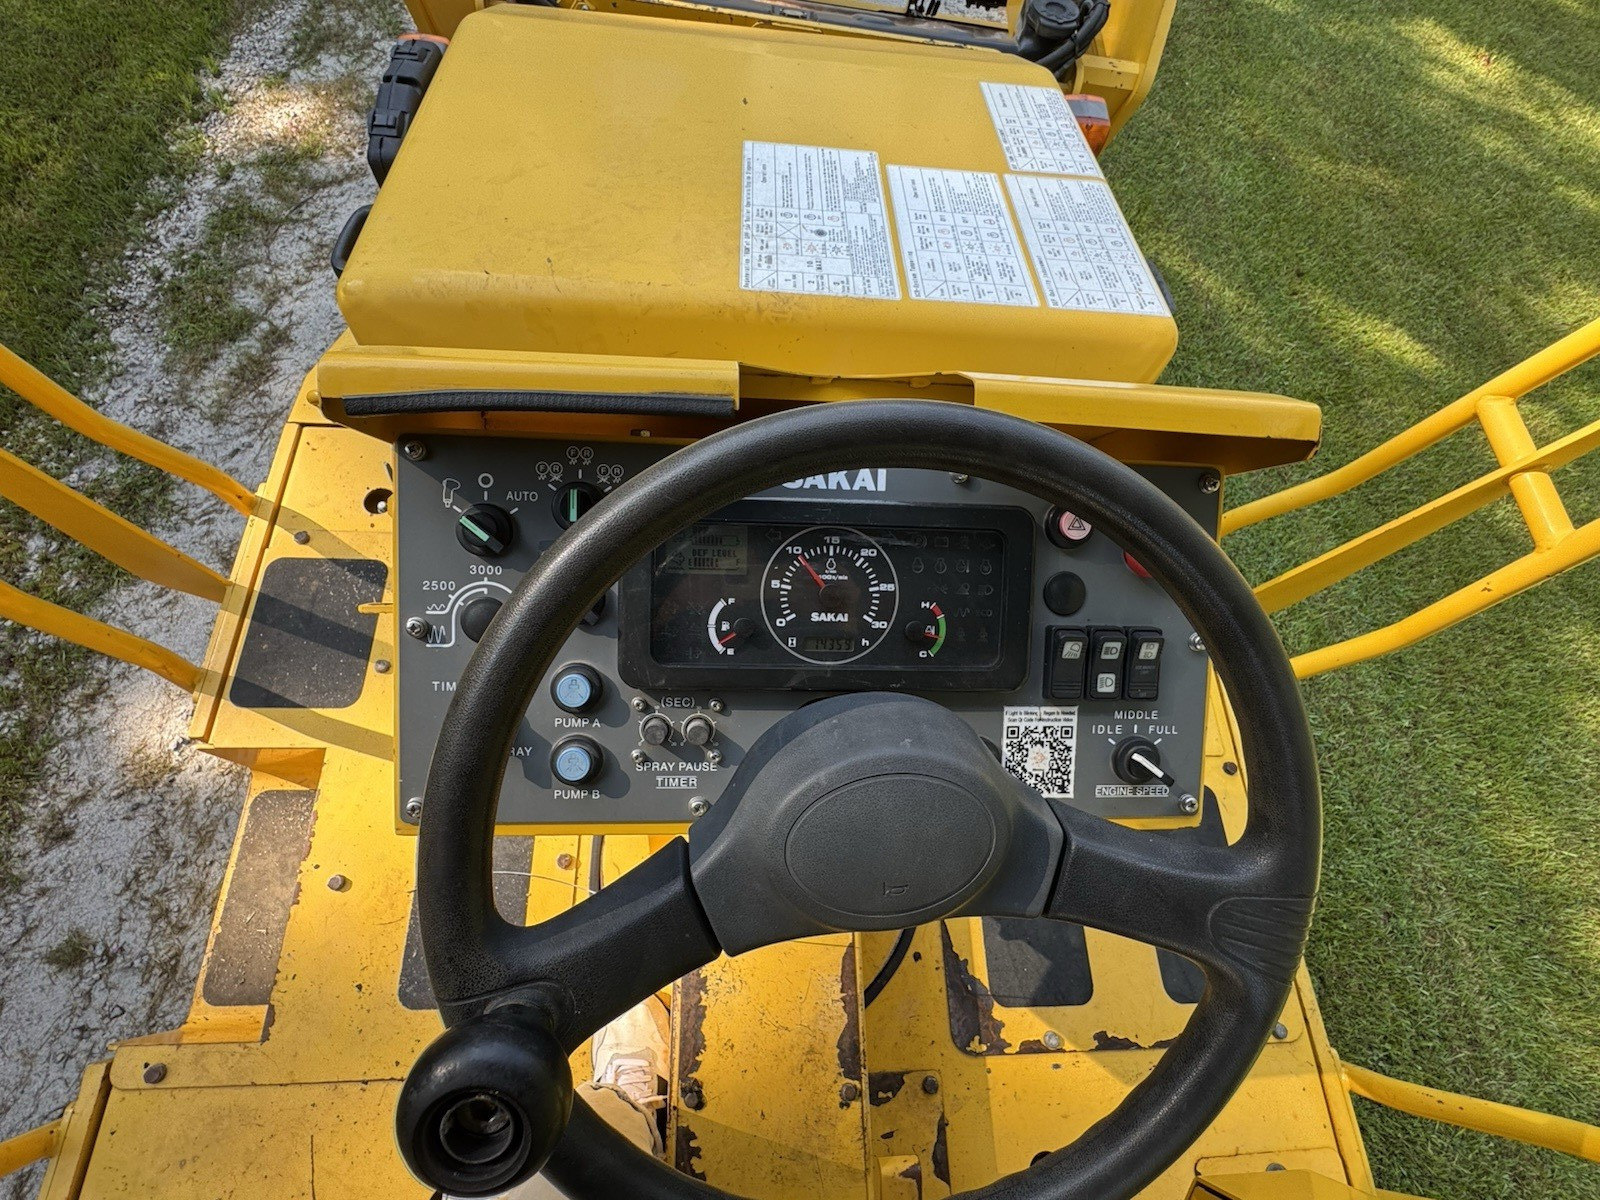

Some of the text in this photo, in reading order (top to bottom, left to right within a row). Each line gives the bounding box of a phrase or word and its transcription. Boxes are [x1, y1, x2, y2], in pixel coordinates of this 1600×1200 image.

[506, 491, 538, 502] AUTO
[824, 536, 840, 544] 15
[786, 546, 802, 555] 10
[860, 549, 877, 557] 20
[469, 565, 502, 575] 3000
[422, 581, 456, 590] 2500
[771, 580, 780, 588] 5
[879, 583, 895, 592] 25
[811, 612, 849, 622] SAKAI
[776, 618, 786, 627] 0
[872, 621, 888, 629] 30
[862, 638, 870, 646] h
[432, 681, 457, 692] TIM
[661, 696, 695, 708] (SEC)
[1114, 711, 1158, 720] MIDDLE
[554, 718, 600, 728] PUMP A
[1092, 725, 1122, 734] IDLE
[1148, 725, 1178, 734] FULL
[509, 747, 533, 757] RAY
[635, 762, 717, 772] SPRAY PAUSE
[656, 777, 697, 787] TIMER
[554, 790, 600, 799] PUMP B
[1095, 787, 1169, 797] ENGINE SPEED
